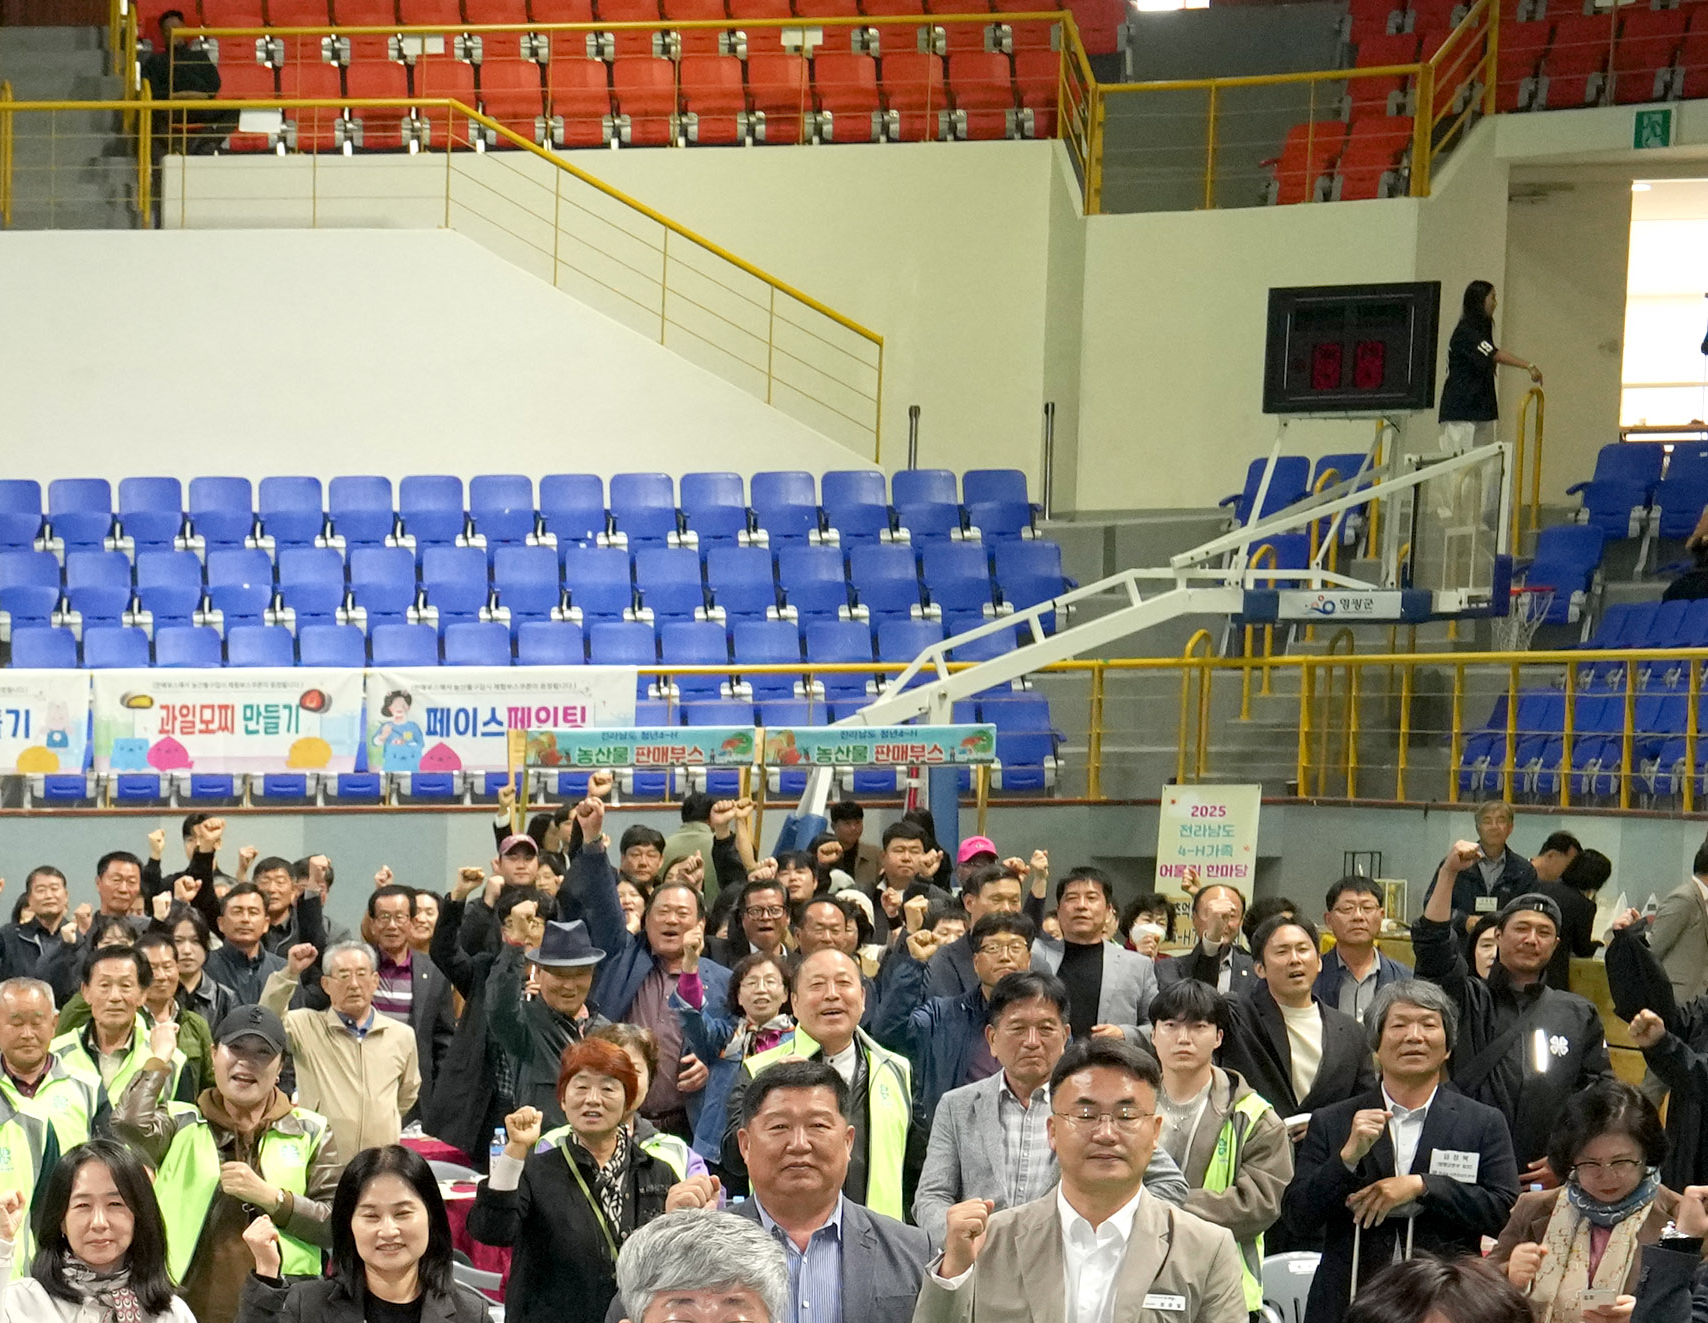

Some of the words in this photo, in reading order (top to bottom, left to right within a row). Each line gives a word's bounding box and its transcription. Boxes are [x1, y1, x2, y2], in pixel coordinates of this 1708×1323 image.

[1477, 340, 1494, 357] 19
[1339, 597, 1374, 611] 영광군
[157, 703, 235, 736] 과일모찌
[242, 703, 300, 736] 만들기
[576, 745, 629, 765] 농산물
[634, 744, 704, 764] 판매부스
[815, 744, 869, 764] 농산물
[873, 743, 944, 763] 판매부스
[1190, 805, 1227, 818] 2025
[1179, 824, 1235, 838] 전라남도
[1177, 844, 1234, 858] 4-H가족
[1206, 864, 1249, 878] 한마당
